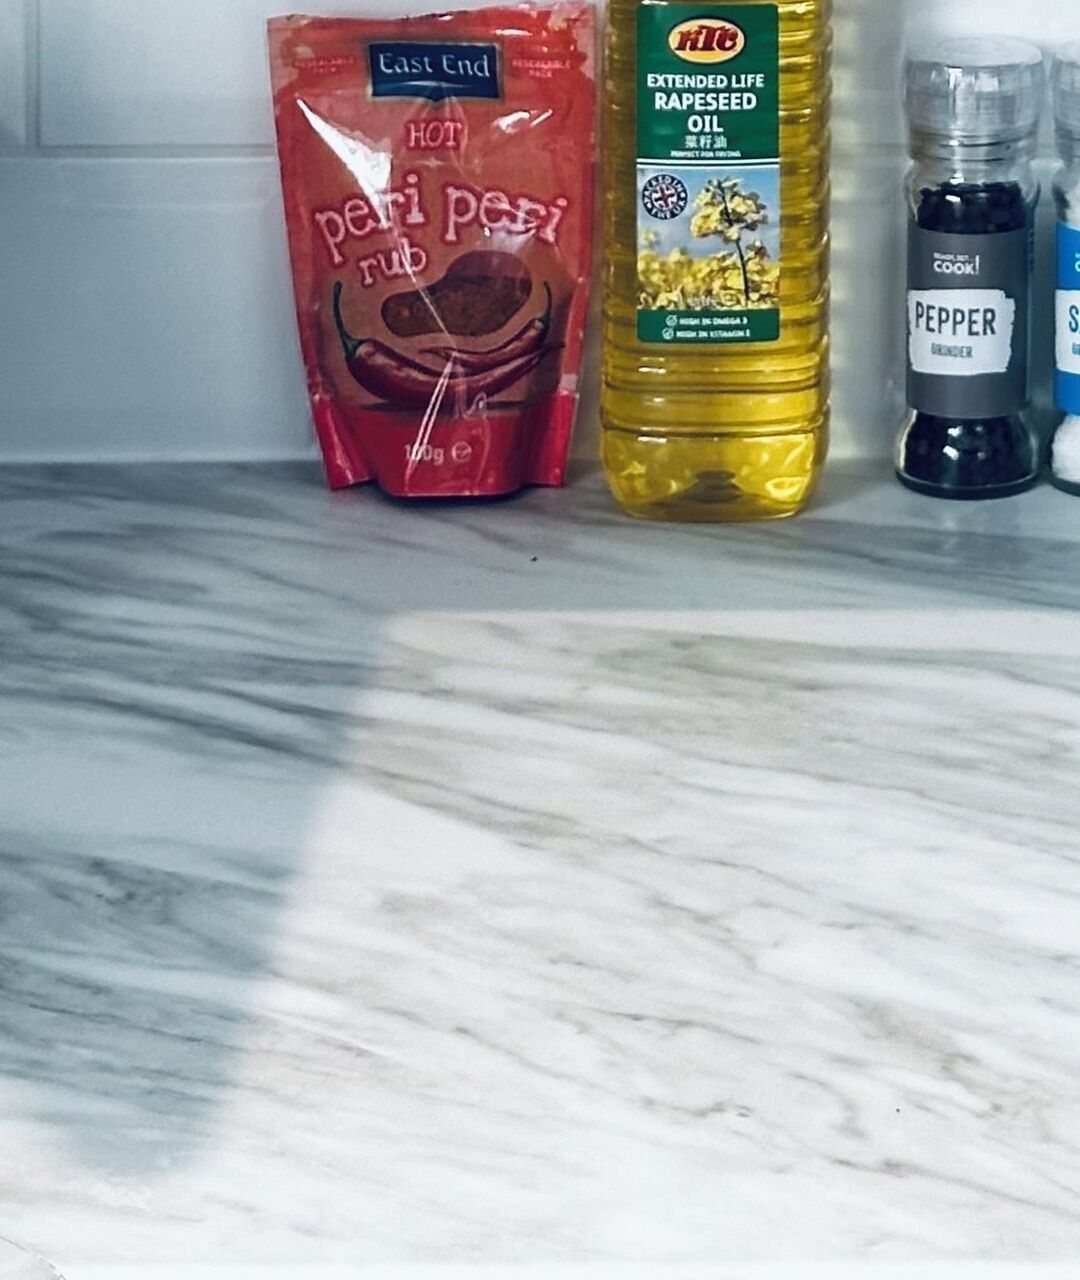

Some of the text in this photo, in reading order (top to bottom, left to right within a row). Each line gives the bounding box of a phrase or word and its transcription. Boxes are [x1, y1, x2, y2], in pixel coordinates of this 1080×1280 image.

[379, 52, 490, 78] East End
[647, 74, 765, 89] EXTENDED LIFE
[654, 92, 757, 111] RAPESEED
[408, 122, 462, 147] HOT
[687, 115, 724, 133] OIL
[445, 185, 568, 243] peri
[358, 237, 427, 286] rub
[915, 300, 996, 336] PEPPER
